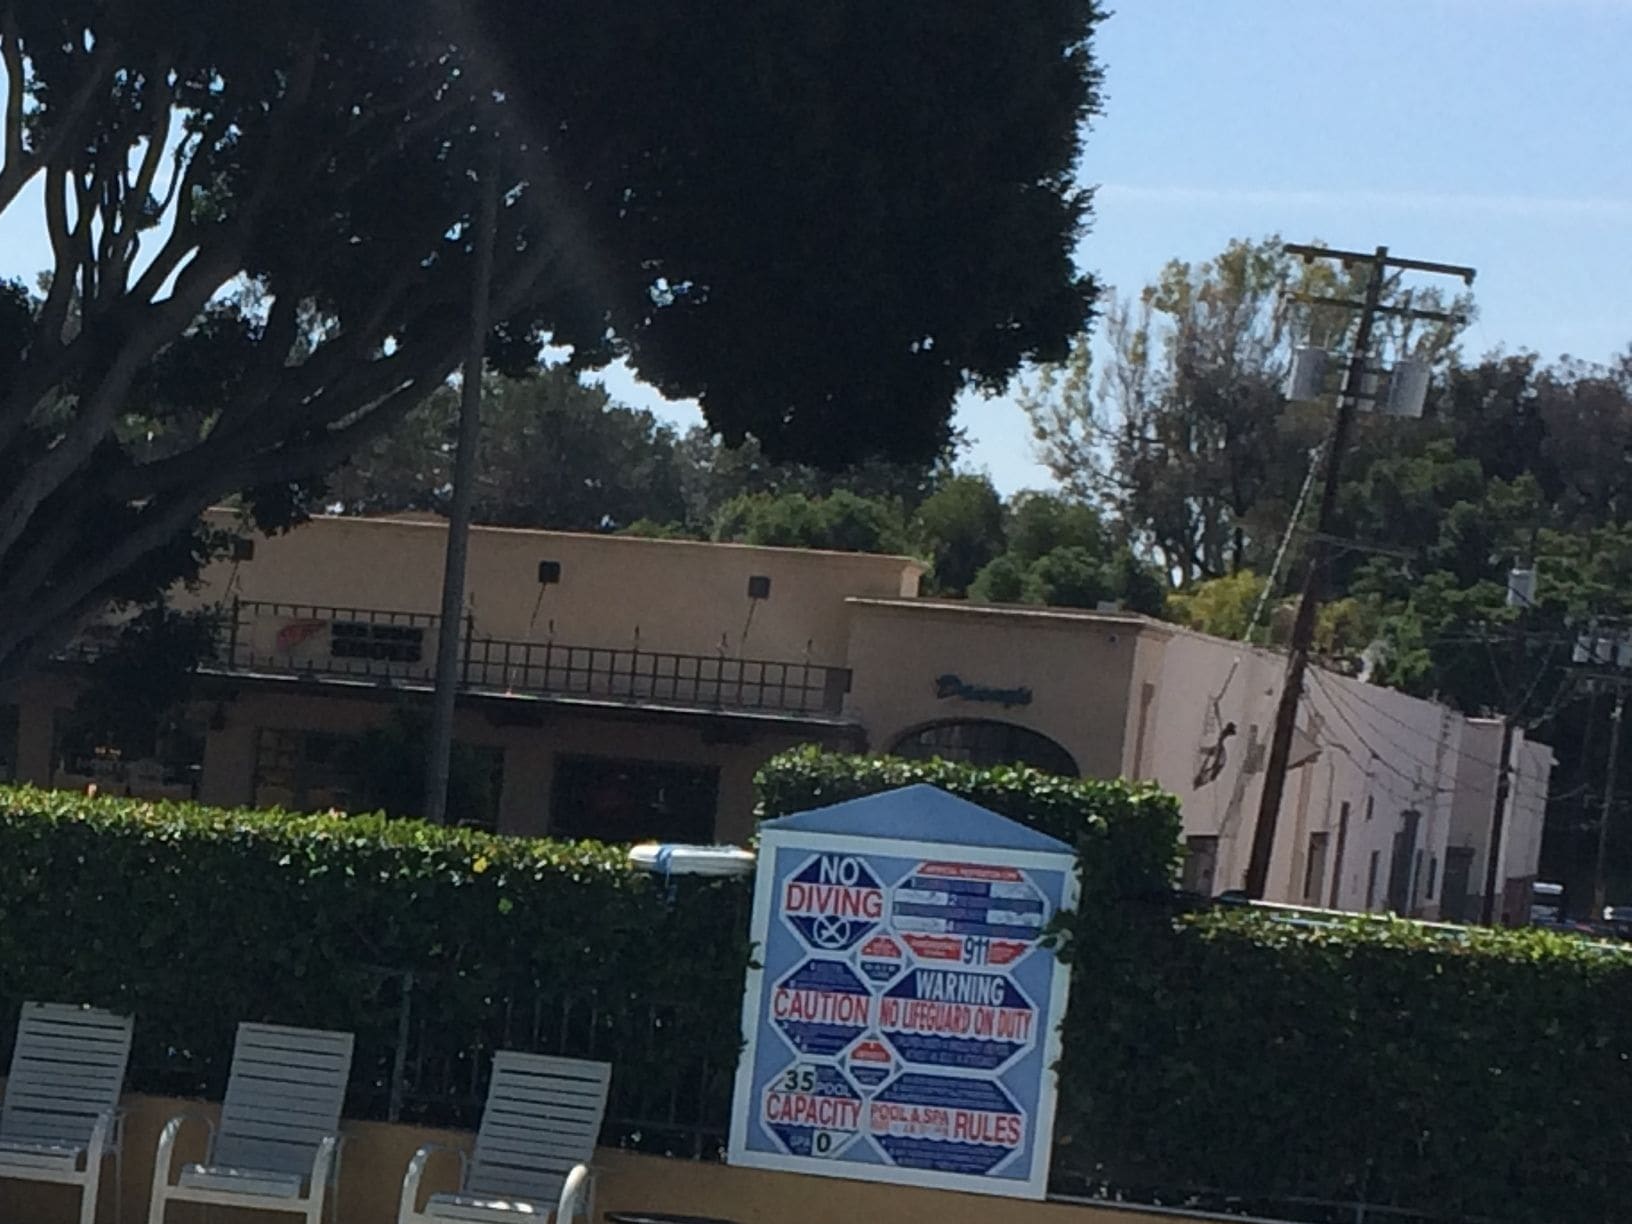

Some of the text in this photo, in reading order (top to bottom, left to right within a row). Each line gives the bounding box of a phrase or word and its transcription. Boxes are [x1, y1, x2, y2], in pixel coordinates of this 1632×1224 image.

[819, 856, 859, 886] NO
[786, 884, 883, 918] DIVING
[963, 937, 990, 966] 911
[917, 970, 1004, 1006] WARNING
[774, 988, 868, 1025] CAUTION
[880, 999, 1033, 1042] NO LIFEGUARD ON DUTY
[785, 1069, 815, 1092] 35
[766, 1094, 863, 1128] CAPACITY
[955, 1111, 1021, 1145] RULES
